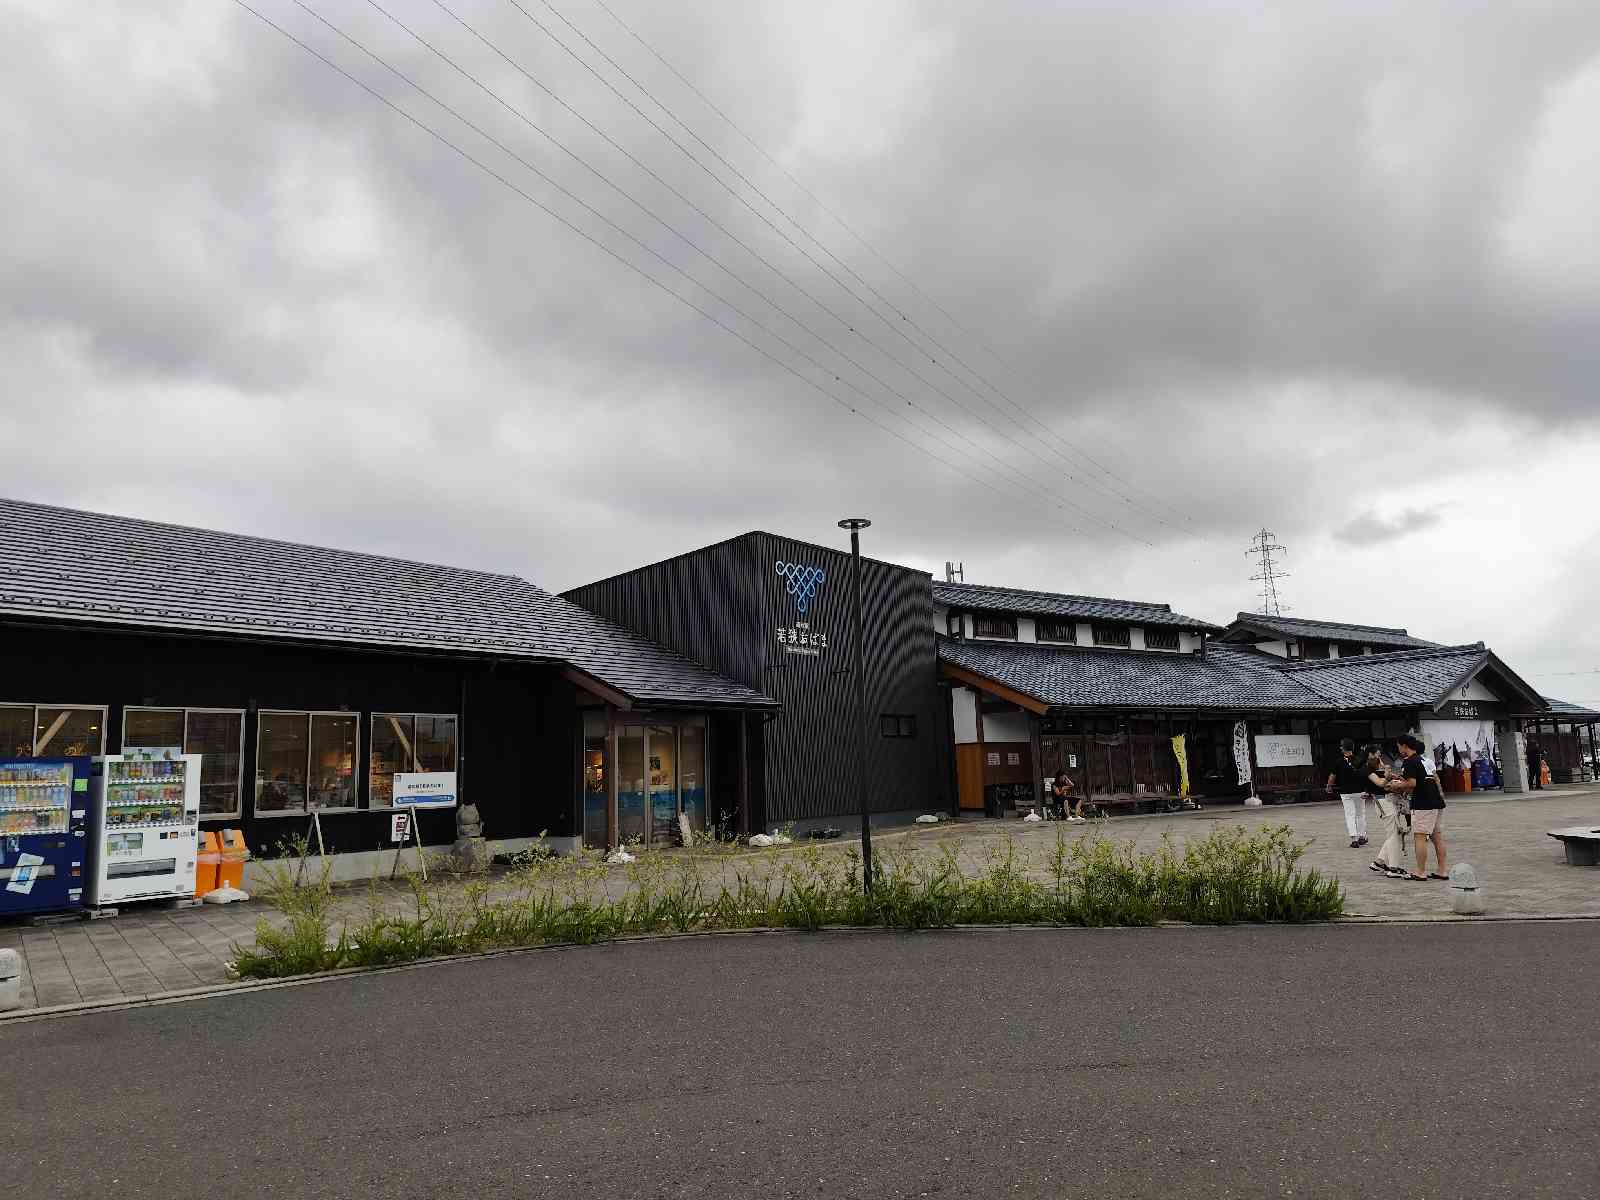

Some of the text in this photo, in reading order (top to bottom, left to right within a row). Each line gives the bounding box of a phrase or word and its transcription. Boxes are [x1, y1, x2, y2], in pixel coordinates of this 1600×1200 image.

[776, 627, 828, 648] 若狭おばま
